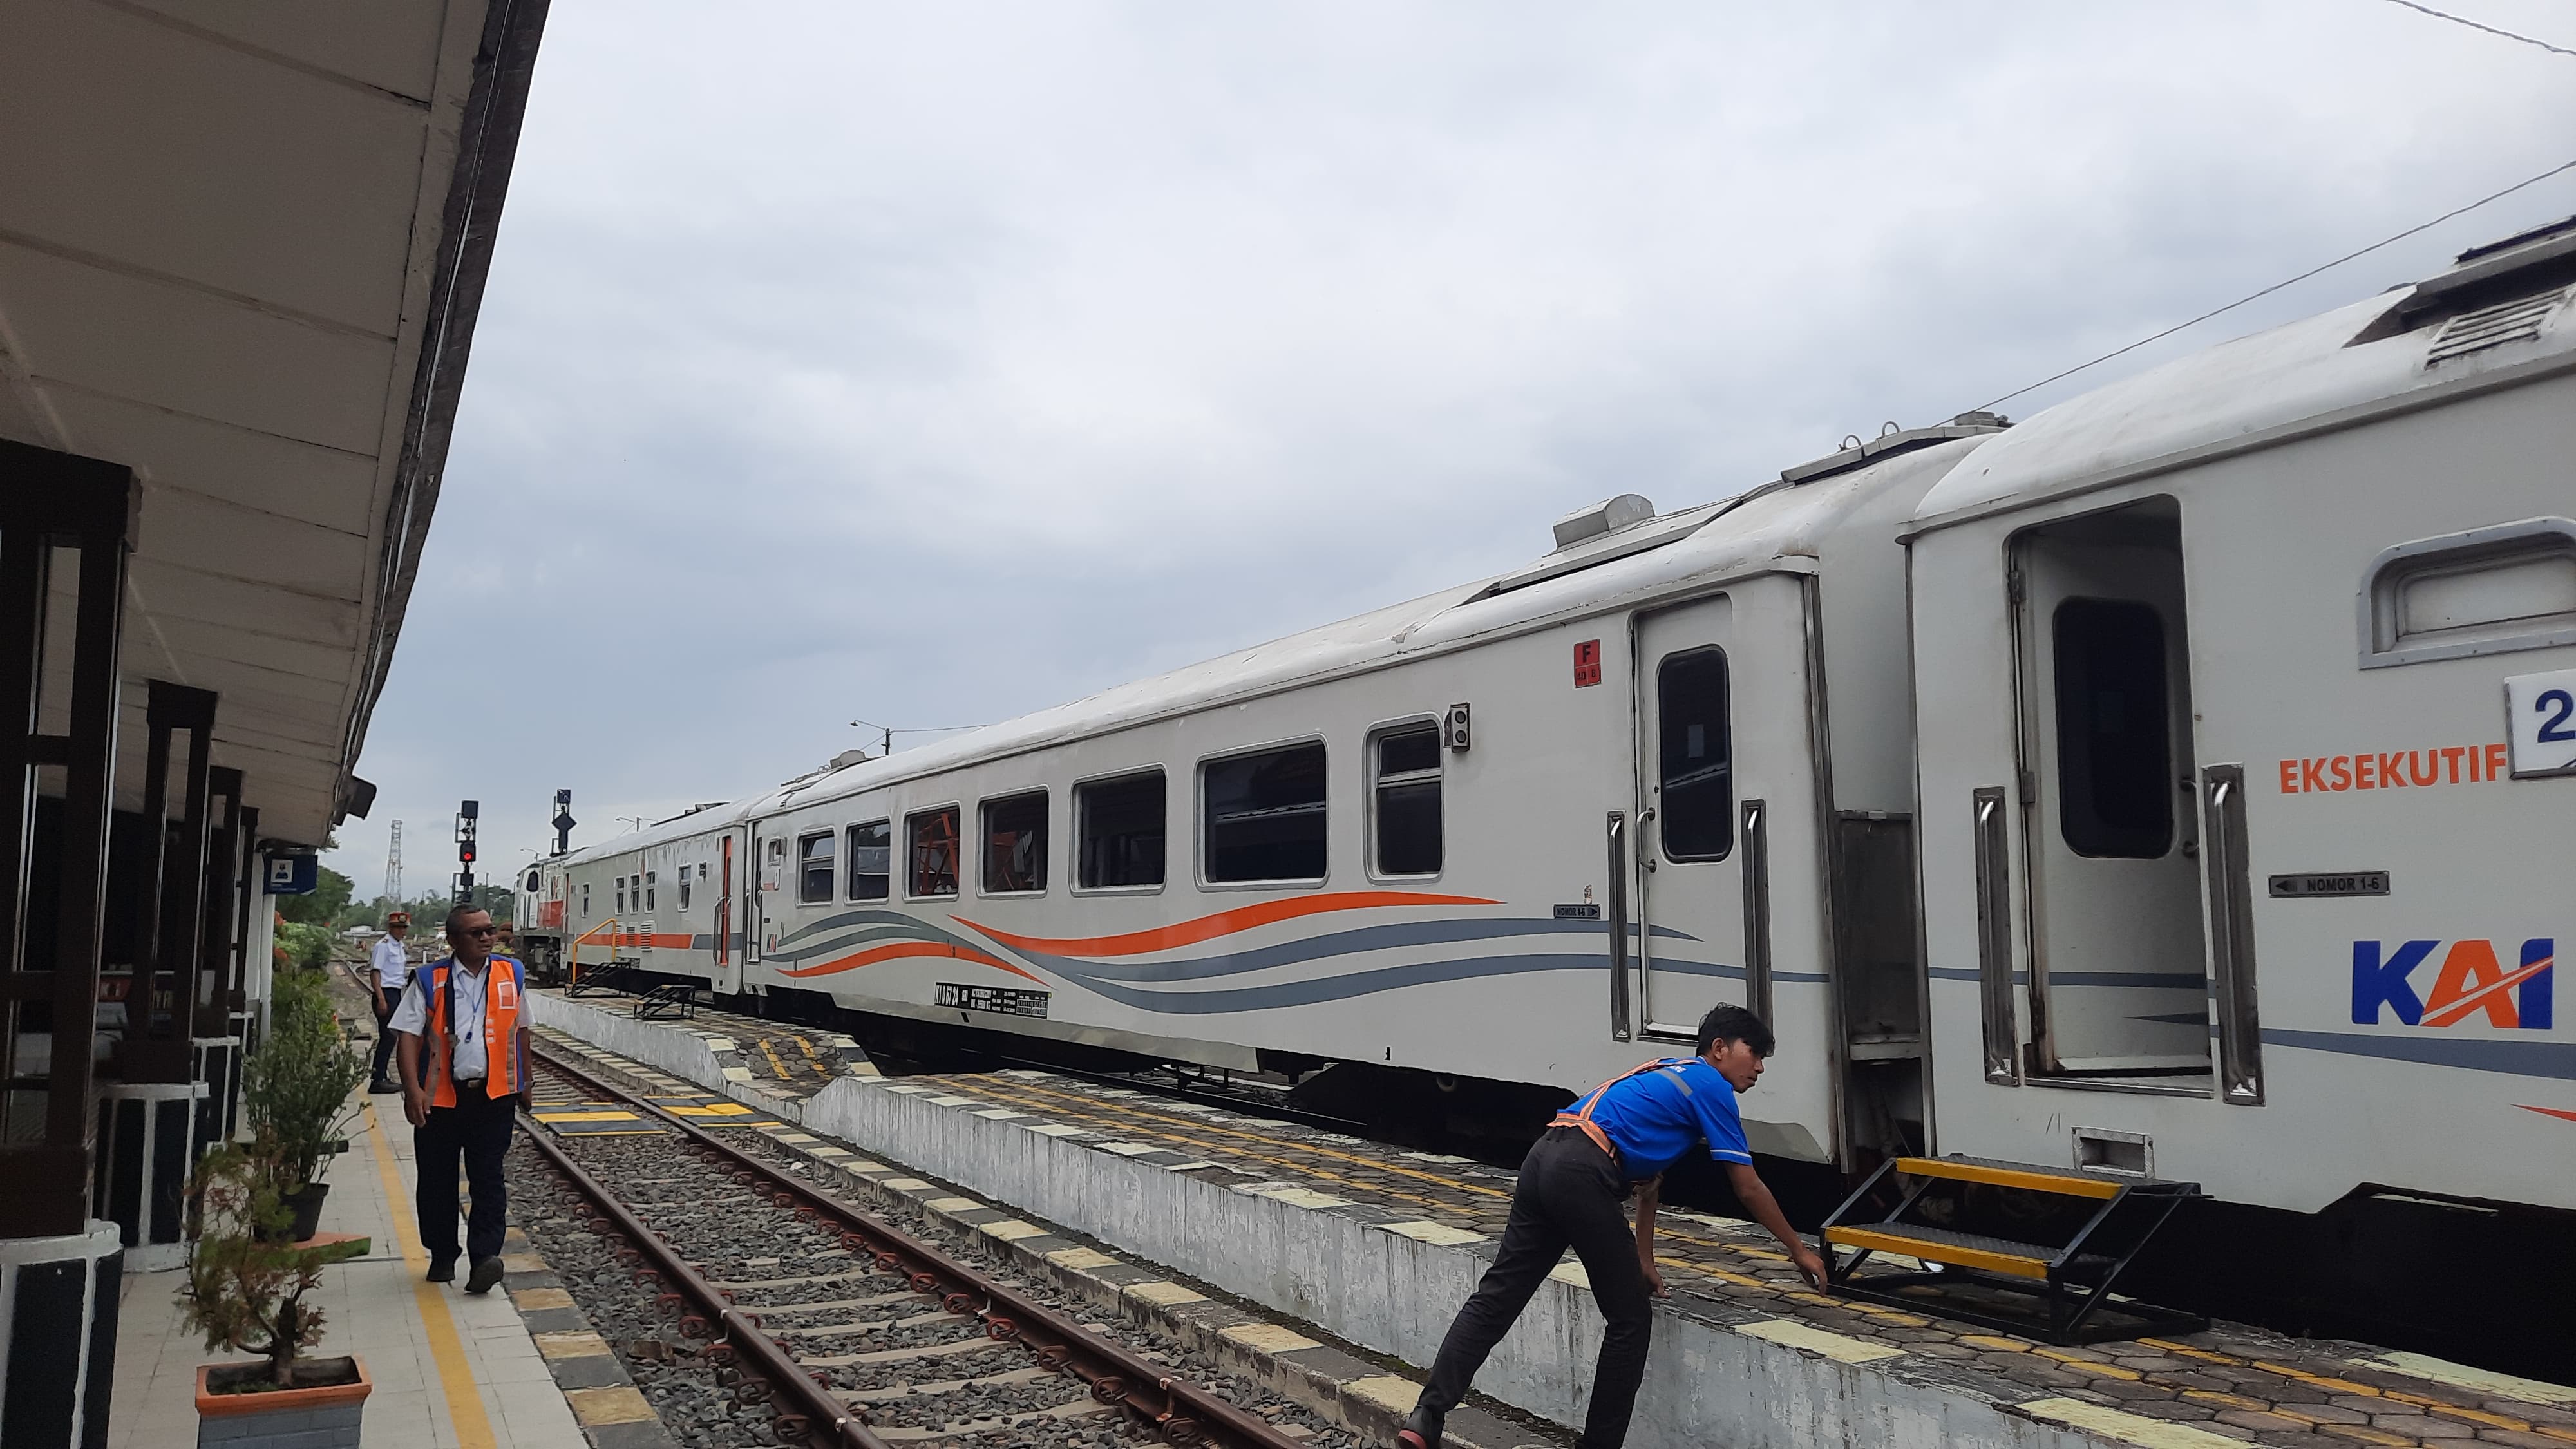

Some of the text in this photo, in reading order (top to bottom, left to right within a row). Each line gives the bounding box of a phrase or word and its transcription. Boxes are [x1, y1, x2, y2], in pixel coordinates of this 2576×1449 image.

[1582, 644, 1591, 663] F
[2535, 689, 2576, 743] 2
[2279, 743, 2506, 794] EKSEKUTIF
[2307, 876, 2380, 892] NOMOR 1-6
[2352, 938, 2555, 1029] KAI
